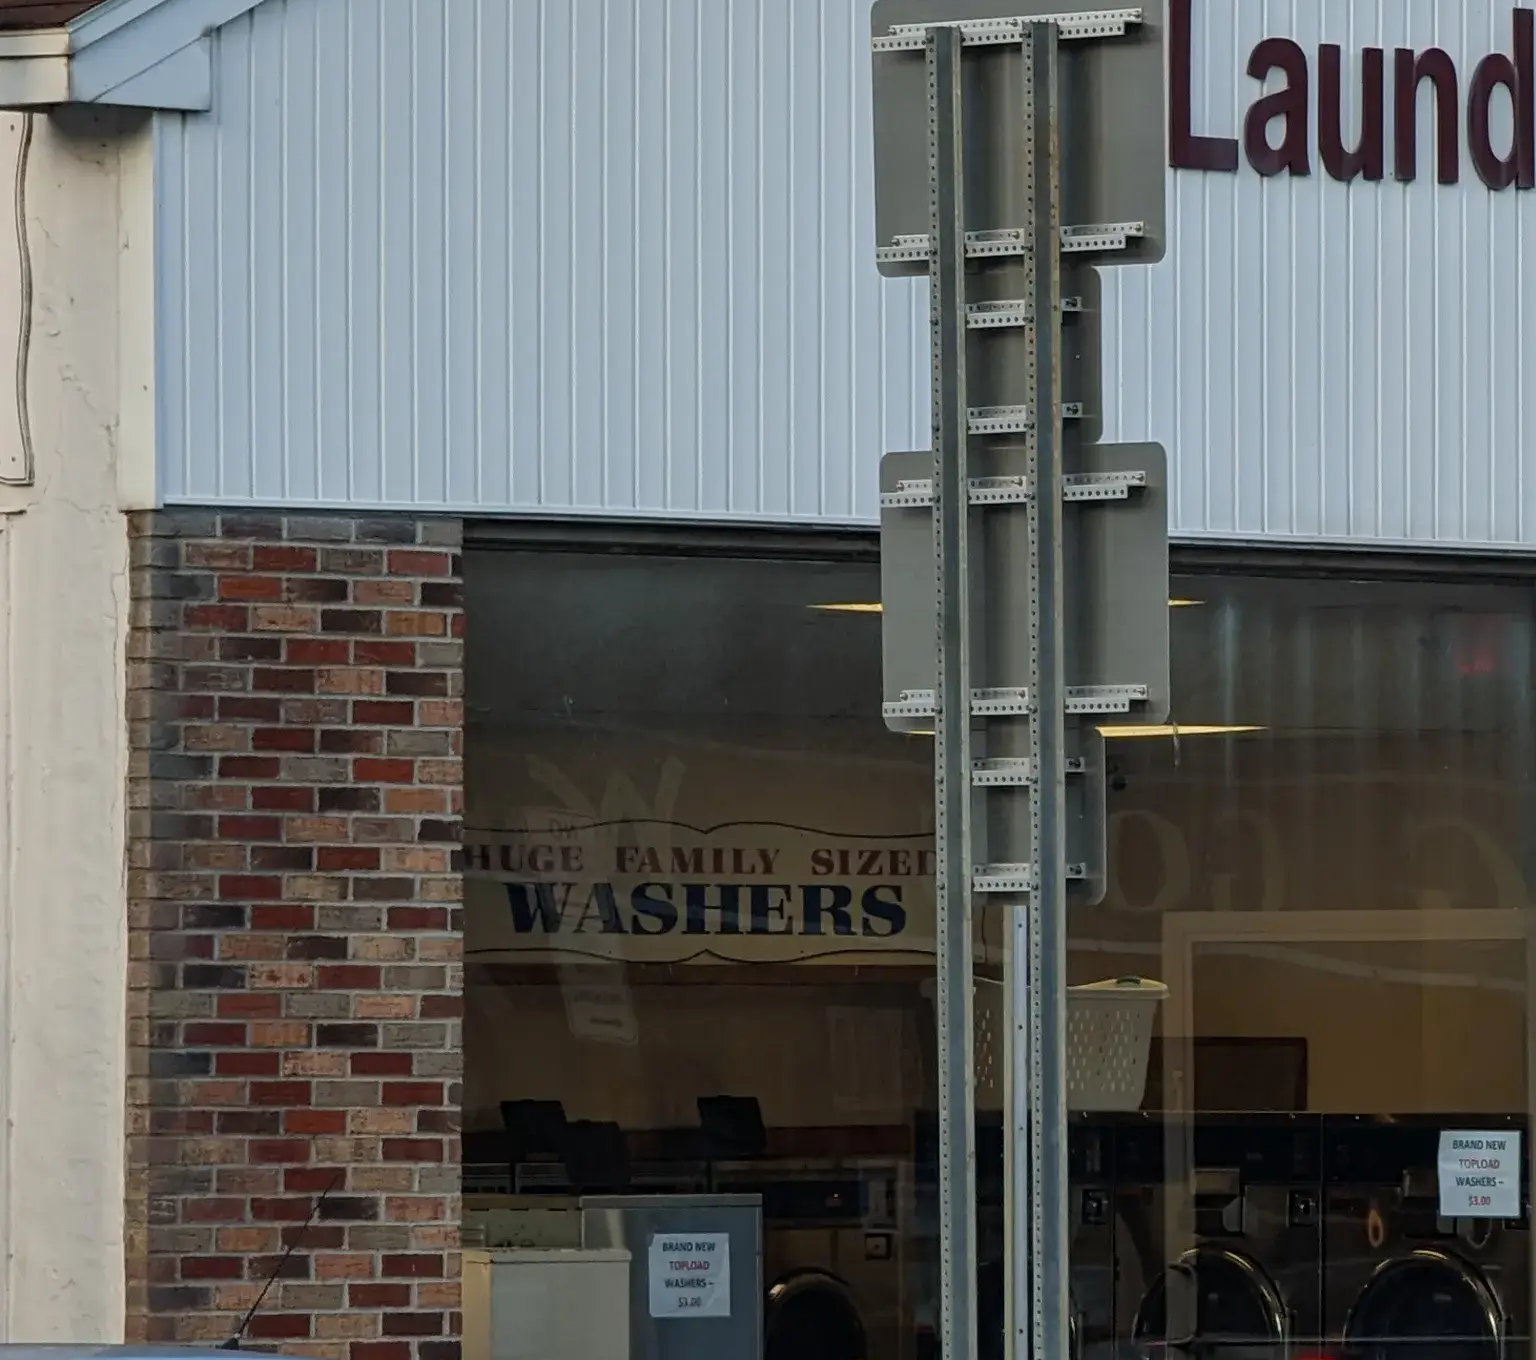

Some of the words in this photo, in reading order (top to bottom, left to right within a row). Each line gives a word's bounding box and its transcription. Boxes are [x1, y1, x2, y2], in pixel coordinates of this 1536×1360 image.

[616, 845, 780, 876] FAMILY
[503, 881, 908, 938] WASHERS
[1452, 1140, 1483, 1150] BRAND
[1486, 1140, 1507, 1151] NEW
[1458, 1159, 1501, 1170] TOPLOAD
[1455, 1177, 1497, 1187] WASHERS
[1468, 1193, 1491, 1207] $3.00
[662, 1242, 693, 1252] BRAND
[695, 1242, 716, 1252] NEW
